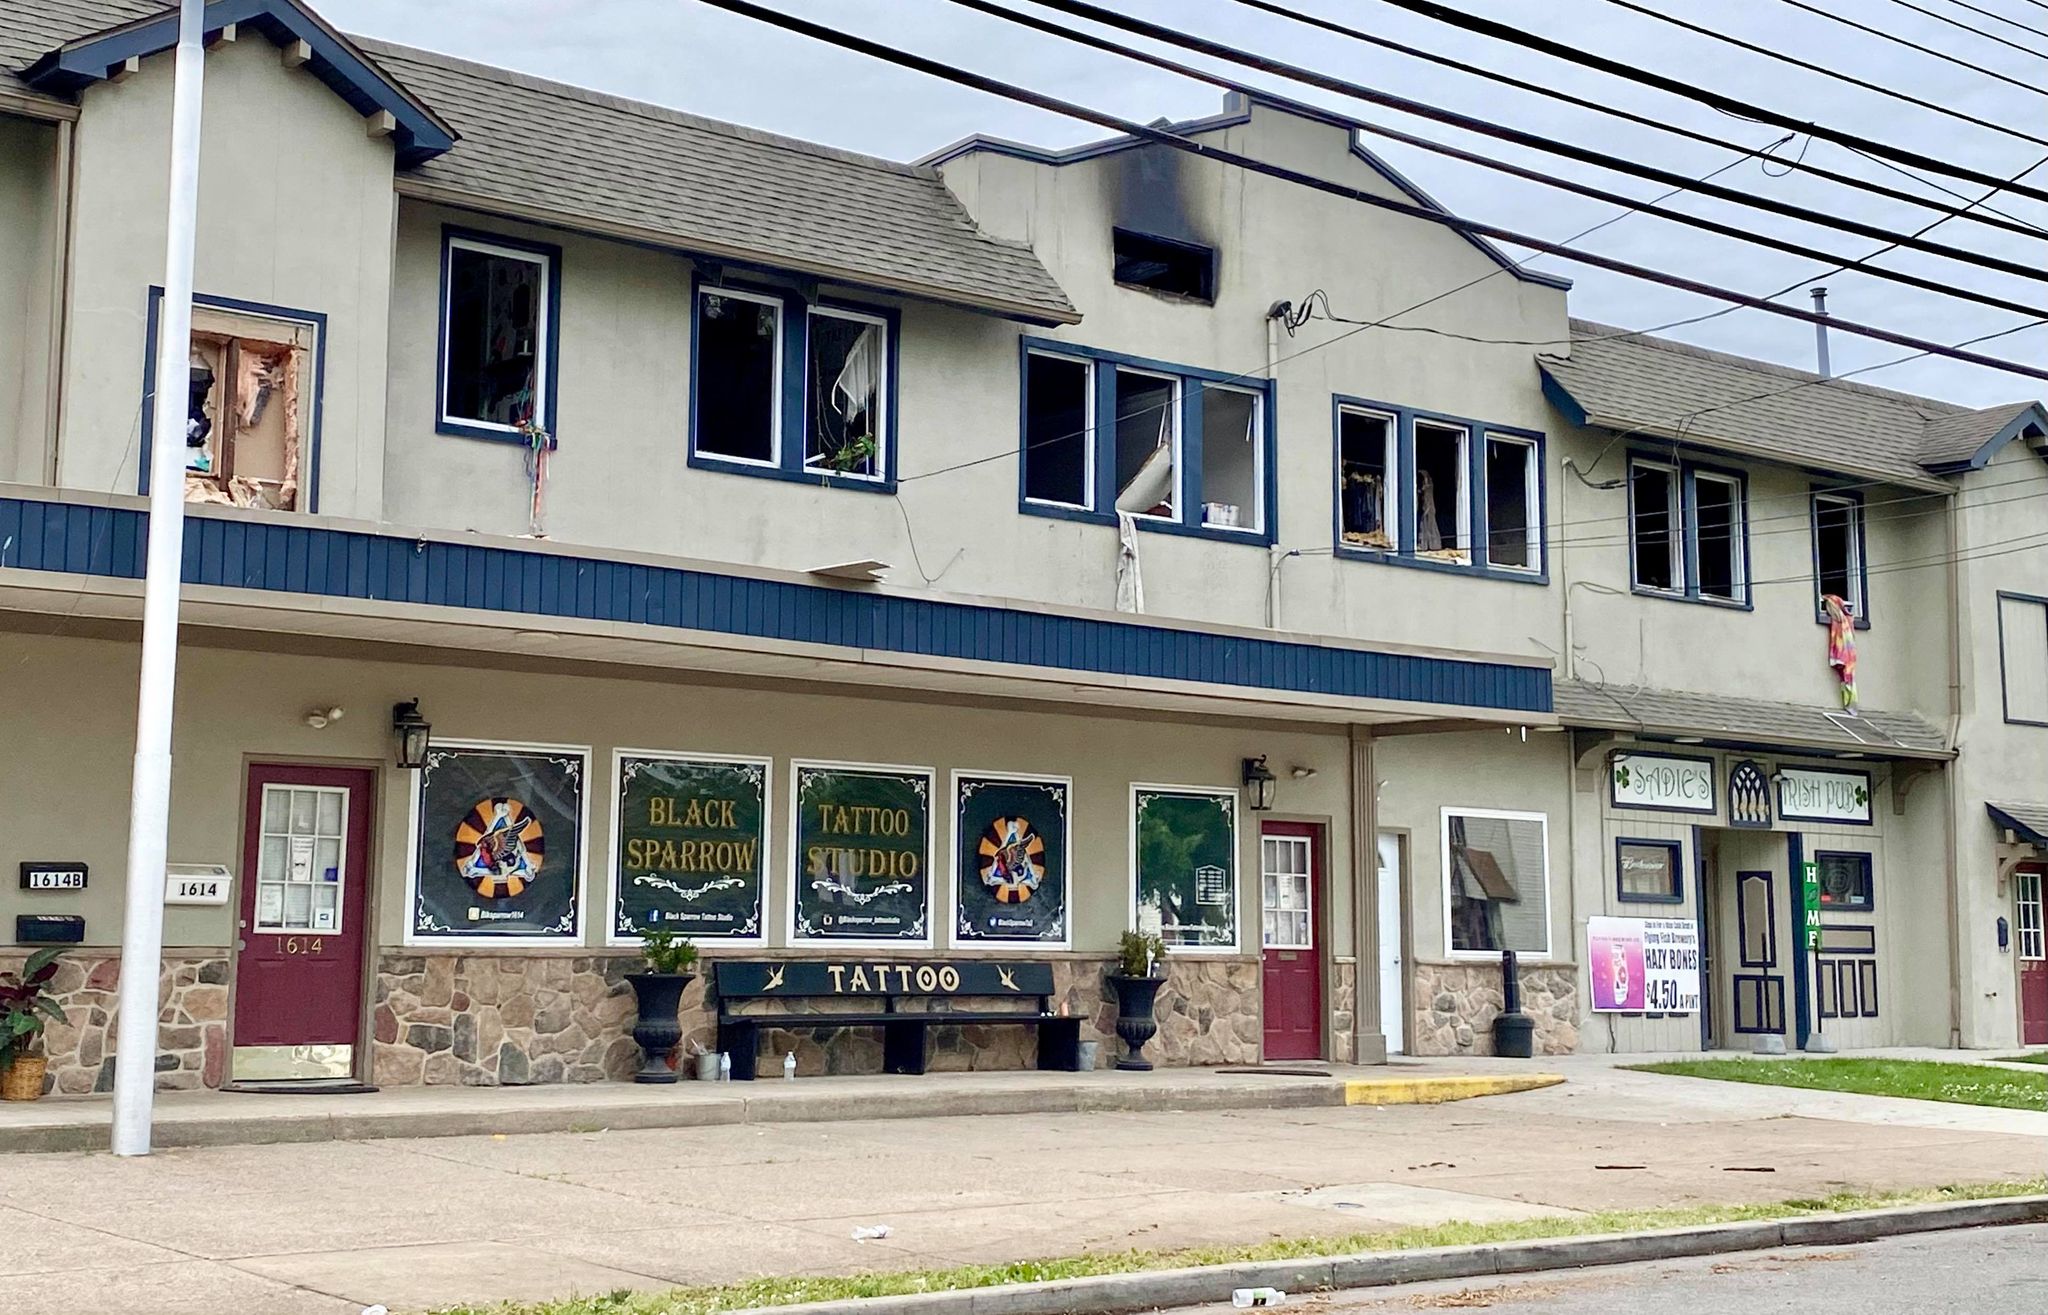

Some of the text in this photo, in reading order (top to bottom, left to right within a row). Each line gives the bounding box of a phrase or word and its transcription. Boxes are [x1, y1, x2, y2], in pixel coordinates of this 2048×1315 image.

[1634, 764, 1710, 800] SADIE'S
[1826, 780, 1855, 813] PUB
[650, 797, 736, 829] BLACK
[818, 804, 910, 836] TATTOO
[626, 836, 758, 872] SPARROW
[806, 846, 918, 878] STUDIO
[33, 873, 81, 887] 1614B
[180, 882, 217, 896] 1614
[275, 936, 322, 954] 1614
[1645, 948, 1667, 970] HAZY
[1669, 948, 1697, 970] BONES
[828, 965, 960, 993] TATTOO
[1646, 979, 1677, 1009] $4.50
[1685, 994, 1698, 1009] PINT
